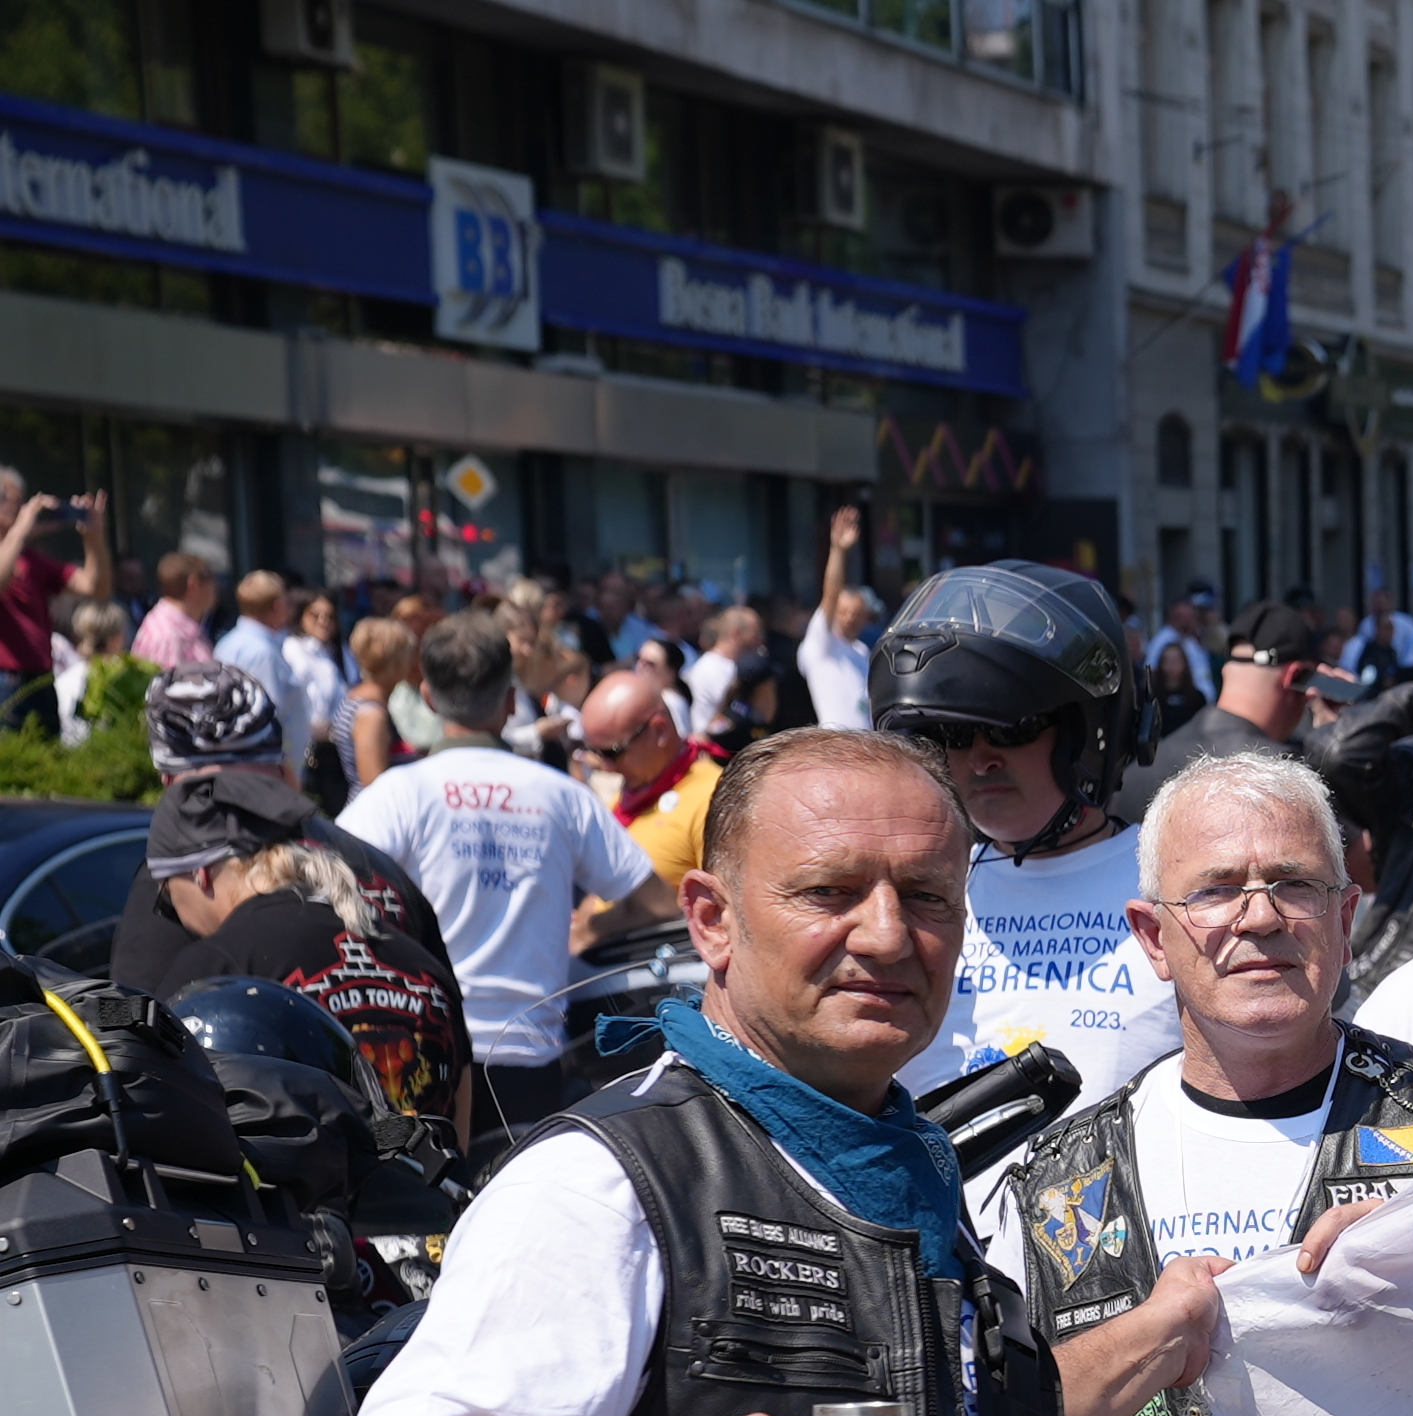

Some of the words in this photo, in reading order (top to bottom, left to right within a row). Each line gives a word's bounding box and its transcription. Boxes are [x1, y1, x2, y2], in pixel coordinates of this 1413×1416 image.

[659, 256, 747, 340] Bosna
[747, 272, 815, 350] Bank
[1012, 937, 1118, 957] MARATON
[328, 987, 364, 1013] OLD
[365, 988, 424, 1015] TOWN
[1070, 1009, 1127, 1031] 2023.
[719, 1216, 750, 1235] FREE
[788, 1227, 839, 1252] ALLIANCE
[733, 1252, 840, 1288] ROCKERS
[736, 1290, 763, 1311] ride
[769, 1297, 801, 1317] with
[809, 1302, 845, 1323] pride
[1055, 1314, 1073, 1331] FREE
[1073, 1306, 1102, 1325] BIKERS
[1102, 1295, 1135, 1320] ALLIANCE
